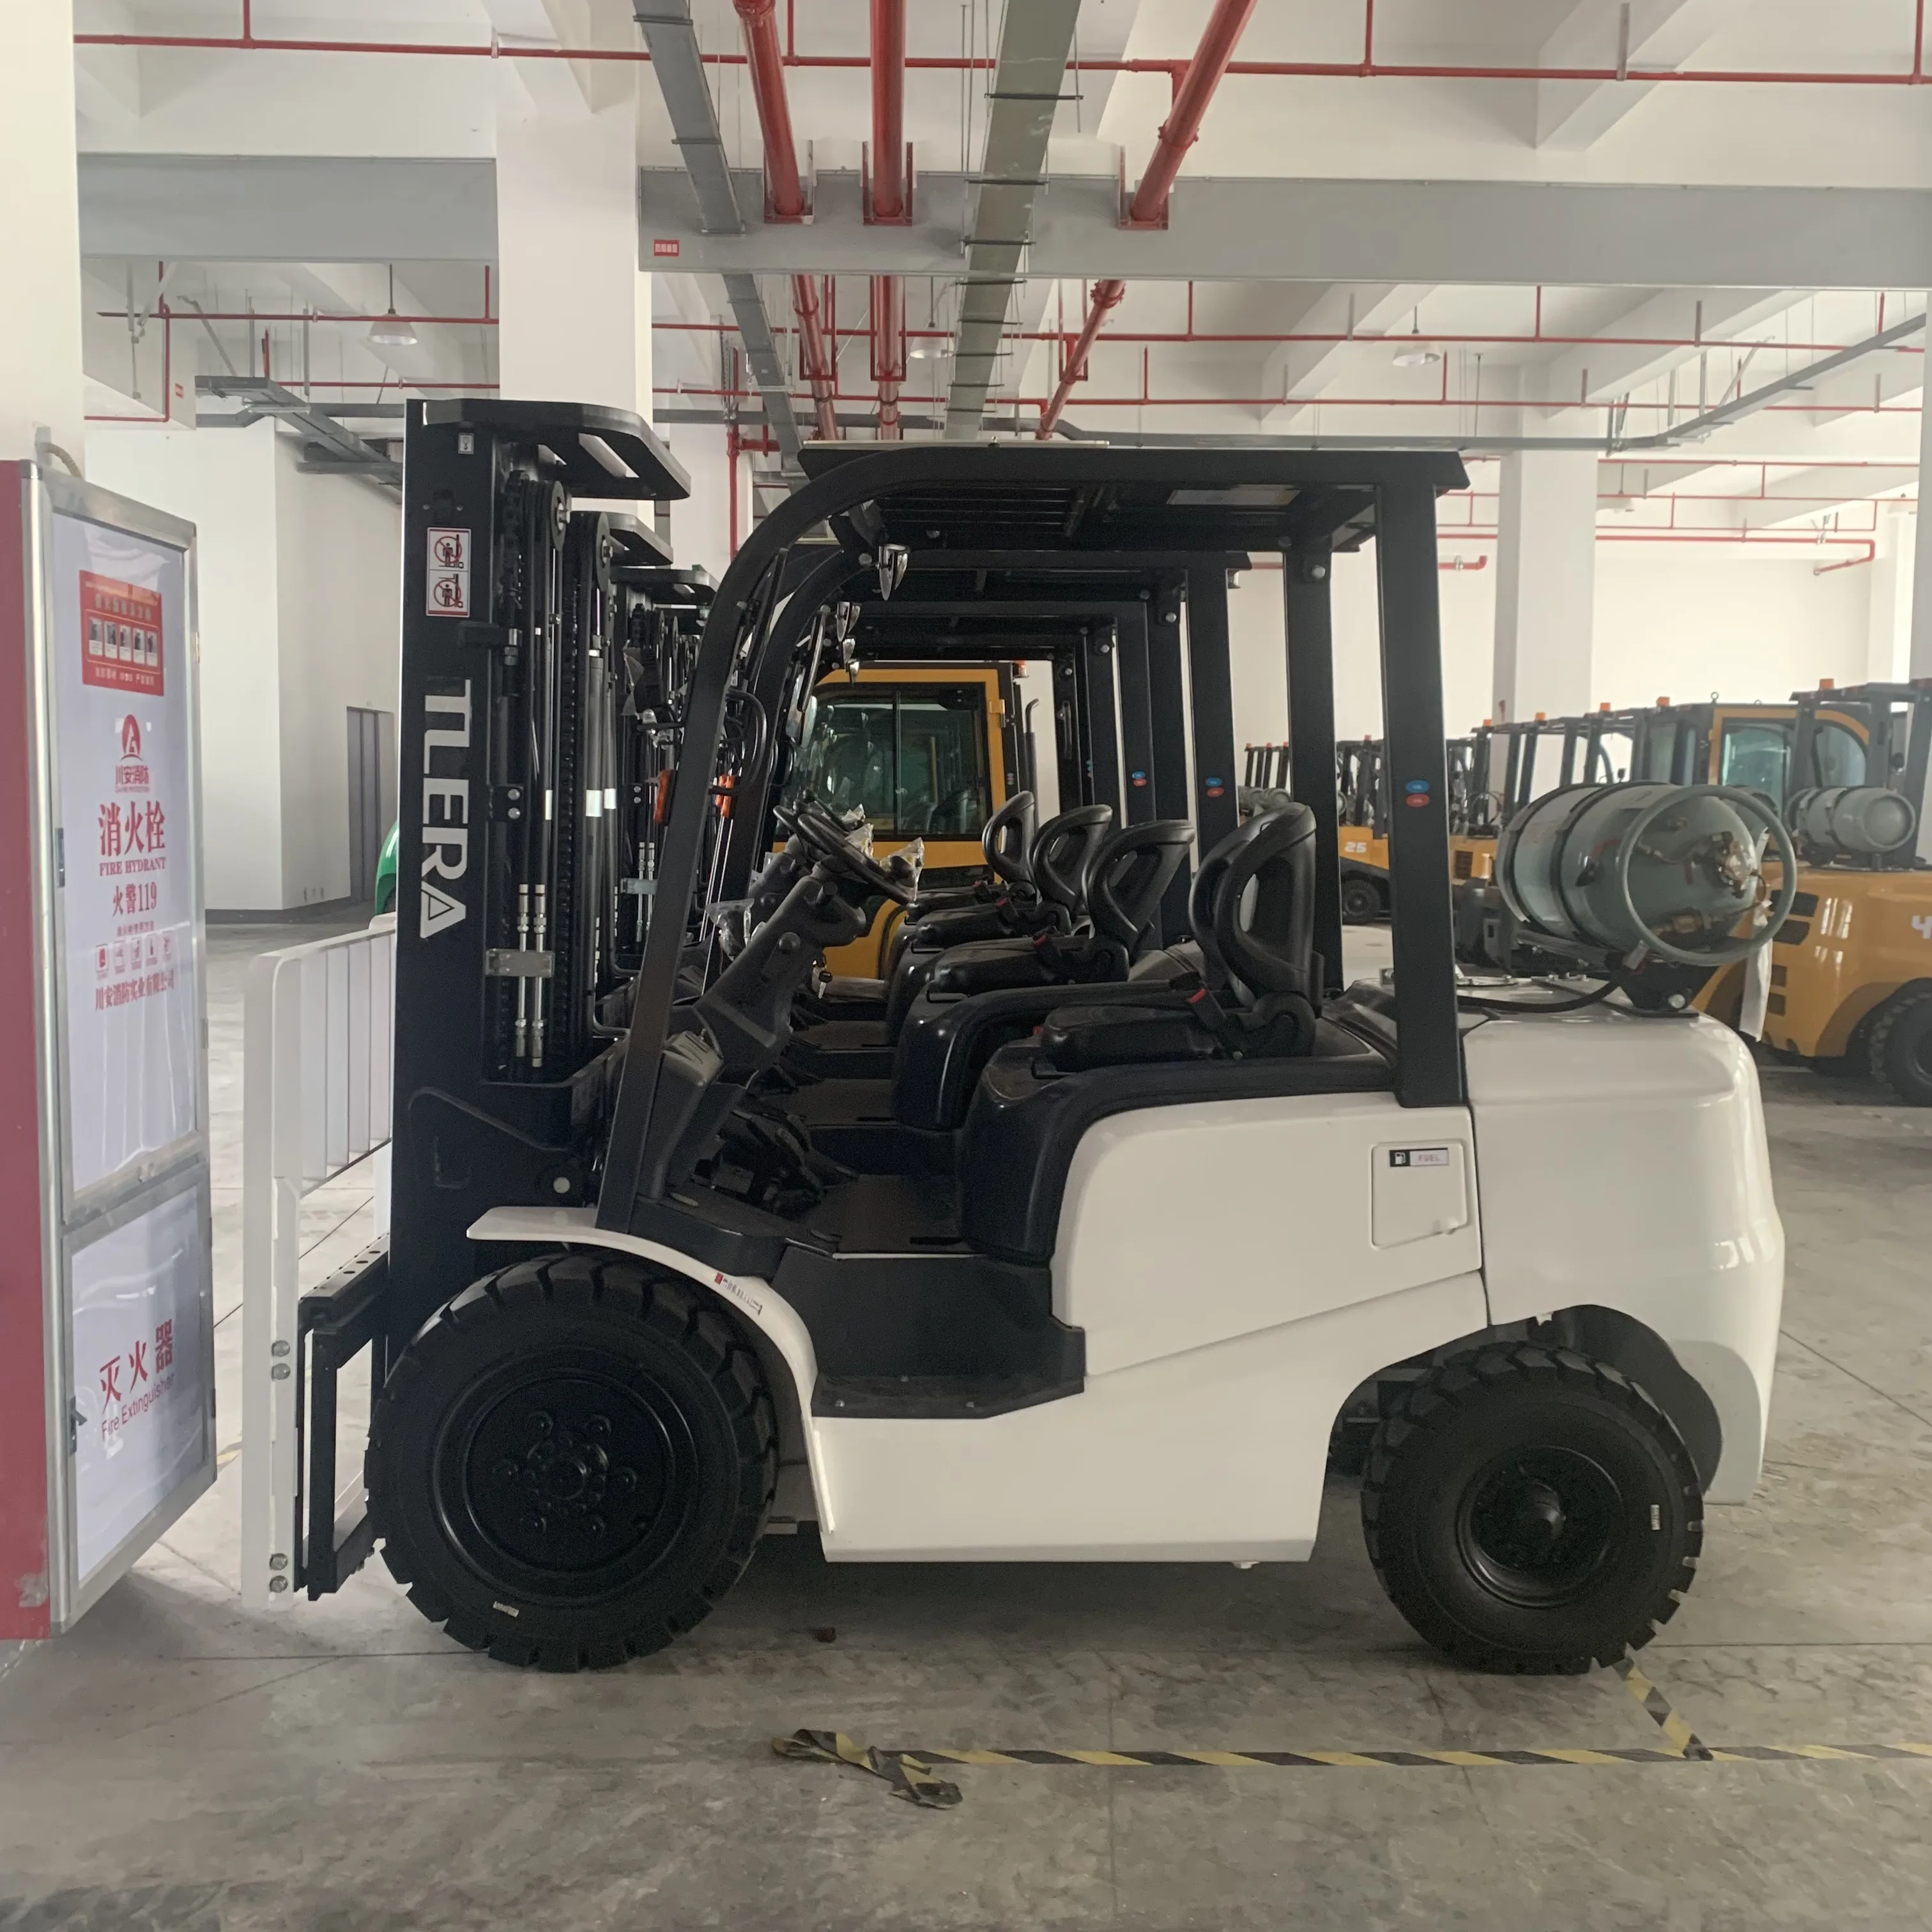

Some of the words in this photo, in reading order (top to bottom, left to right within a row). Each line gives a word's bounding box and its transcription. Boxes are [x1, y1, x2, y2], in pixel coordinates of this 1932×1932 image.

[98, 801, 165, 857] 消火栓
[420, 678, 471, 939] TLERA
[99, 861, 123, 877] FIRE
[125, 857, 166, 874] HYDRANT
[1344, 841, 1367, 853] 25
[112, 881, 157, 917] 火警119
[100, 1319, 173, 1415] 灭火器
[102, 1416, 119, 1442] Fire
[121, 1374, 175, 1425] Extinguisher
